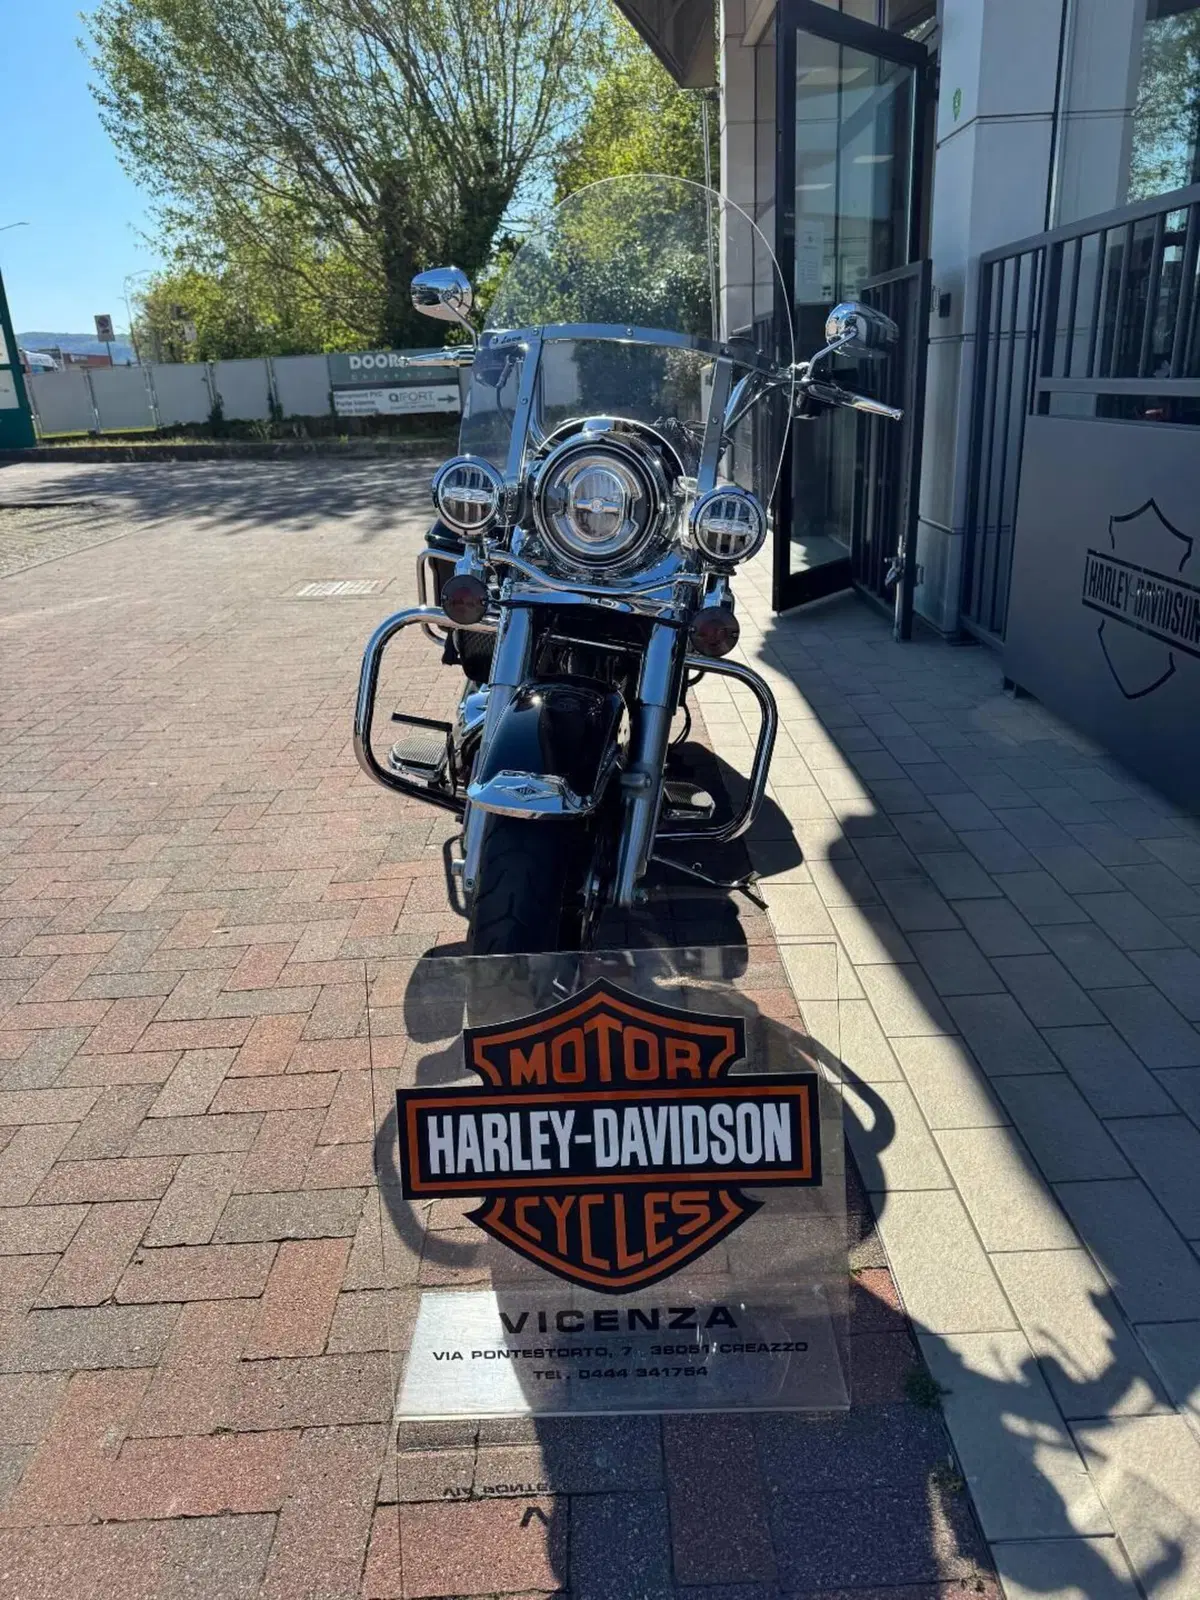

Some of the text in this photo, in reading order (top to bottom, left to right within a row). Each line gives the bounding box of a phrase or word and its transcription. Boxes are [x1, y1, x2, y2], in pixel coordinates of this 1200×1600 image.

[509, 1012, 702, 1086] MOTOR
[427, 1102, 792, 1174] HARLEY-DAVIDSON
[515, 1190, 711, 1271] CYCLES
[499, 1306, 738, 1334] VICENZA
[433, 1350, 464, 1361] VIA
[472, 1346, 614, 1360] PONTESTORTO,
[620, 1346, 632, 1356] 7
[721, 1341, 809, 1354] CREAZZO
[533, 1366, 708, 1381] TEL. 0444 341754
